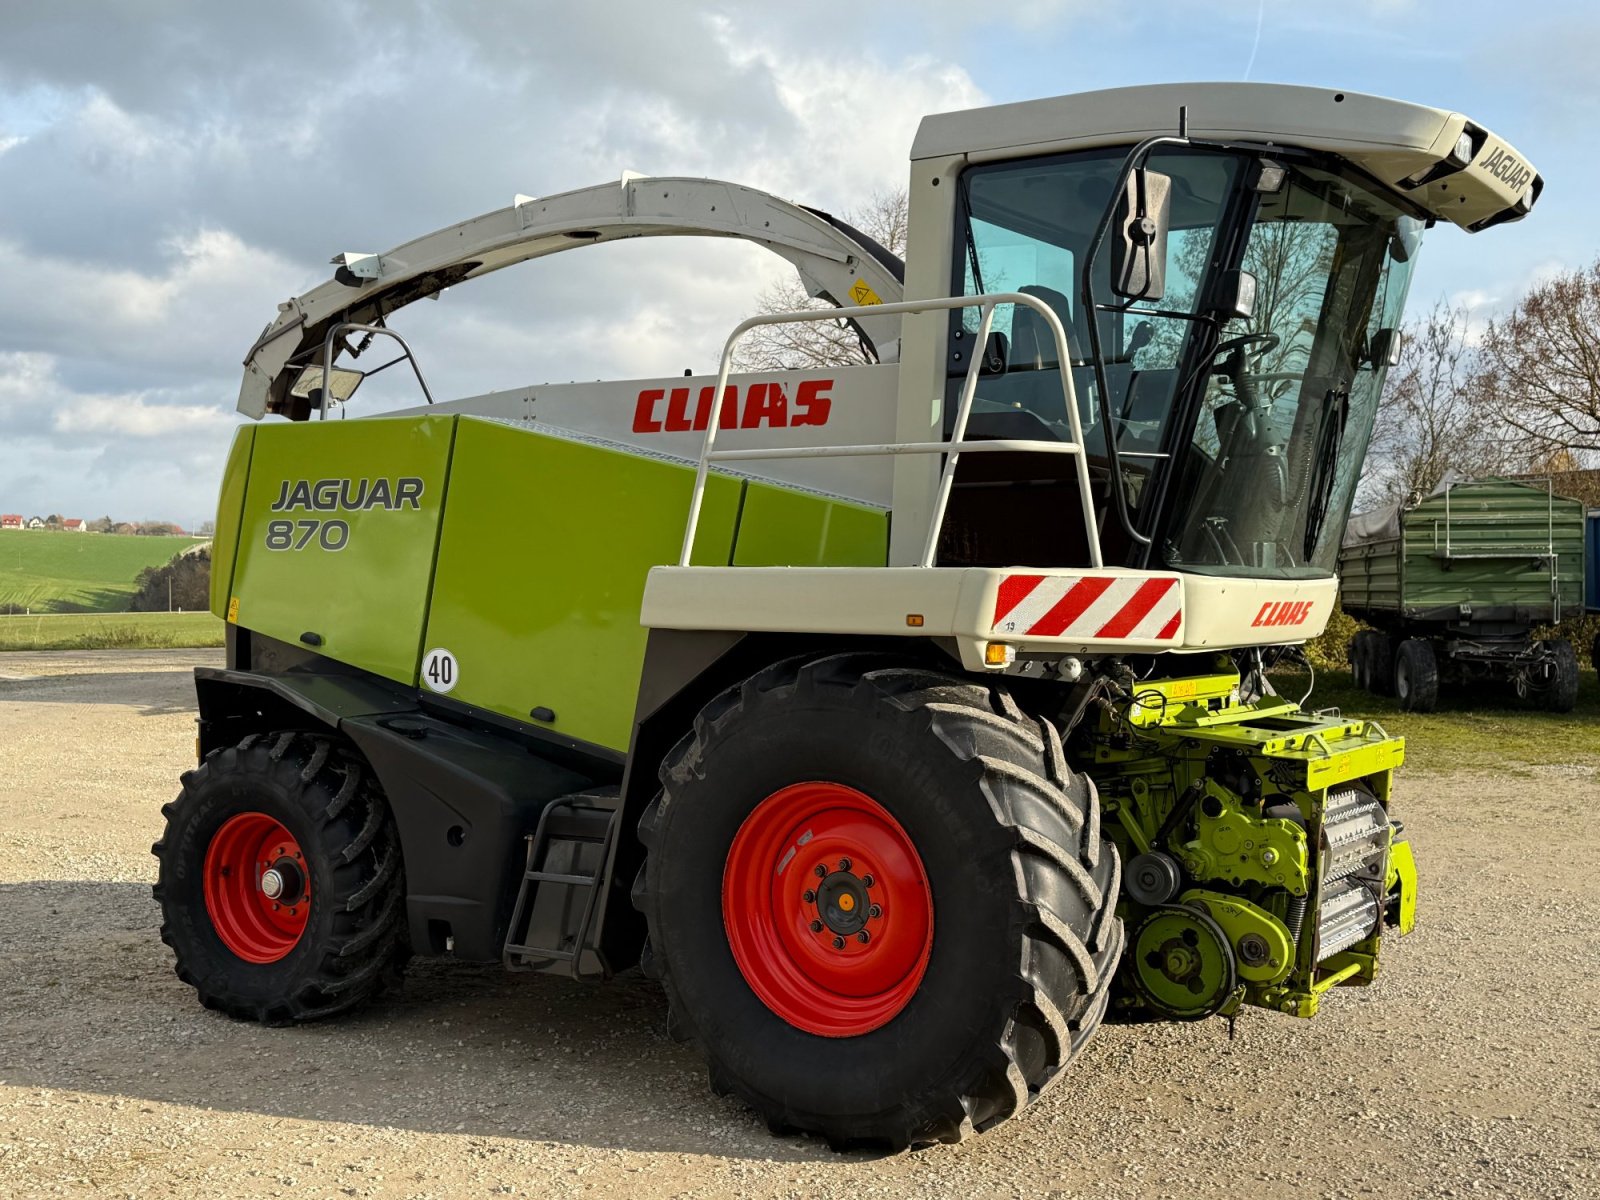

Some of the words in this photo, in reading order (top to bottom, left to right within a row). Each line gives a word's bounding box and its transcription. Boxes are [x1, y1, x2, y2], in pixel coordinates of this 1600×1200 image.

[1479, 146, 1531, 193] JAGUAR
[632, 379, 834, 433] CLAAS
[271, 477, 425, 512] JAGUAR
[265, 519, 350, 551] 870
[1251, 601, 1314, 627] CLAAS
[428, 655, 452, 684] 40
